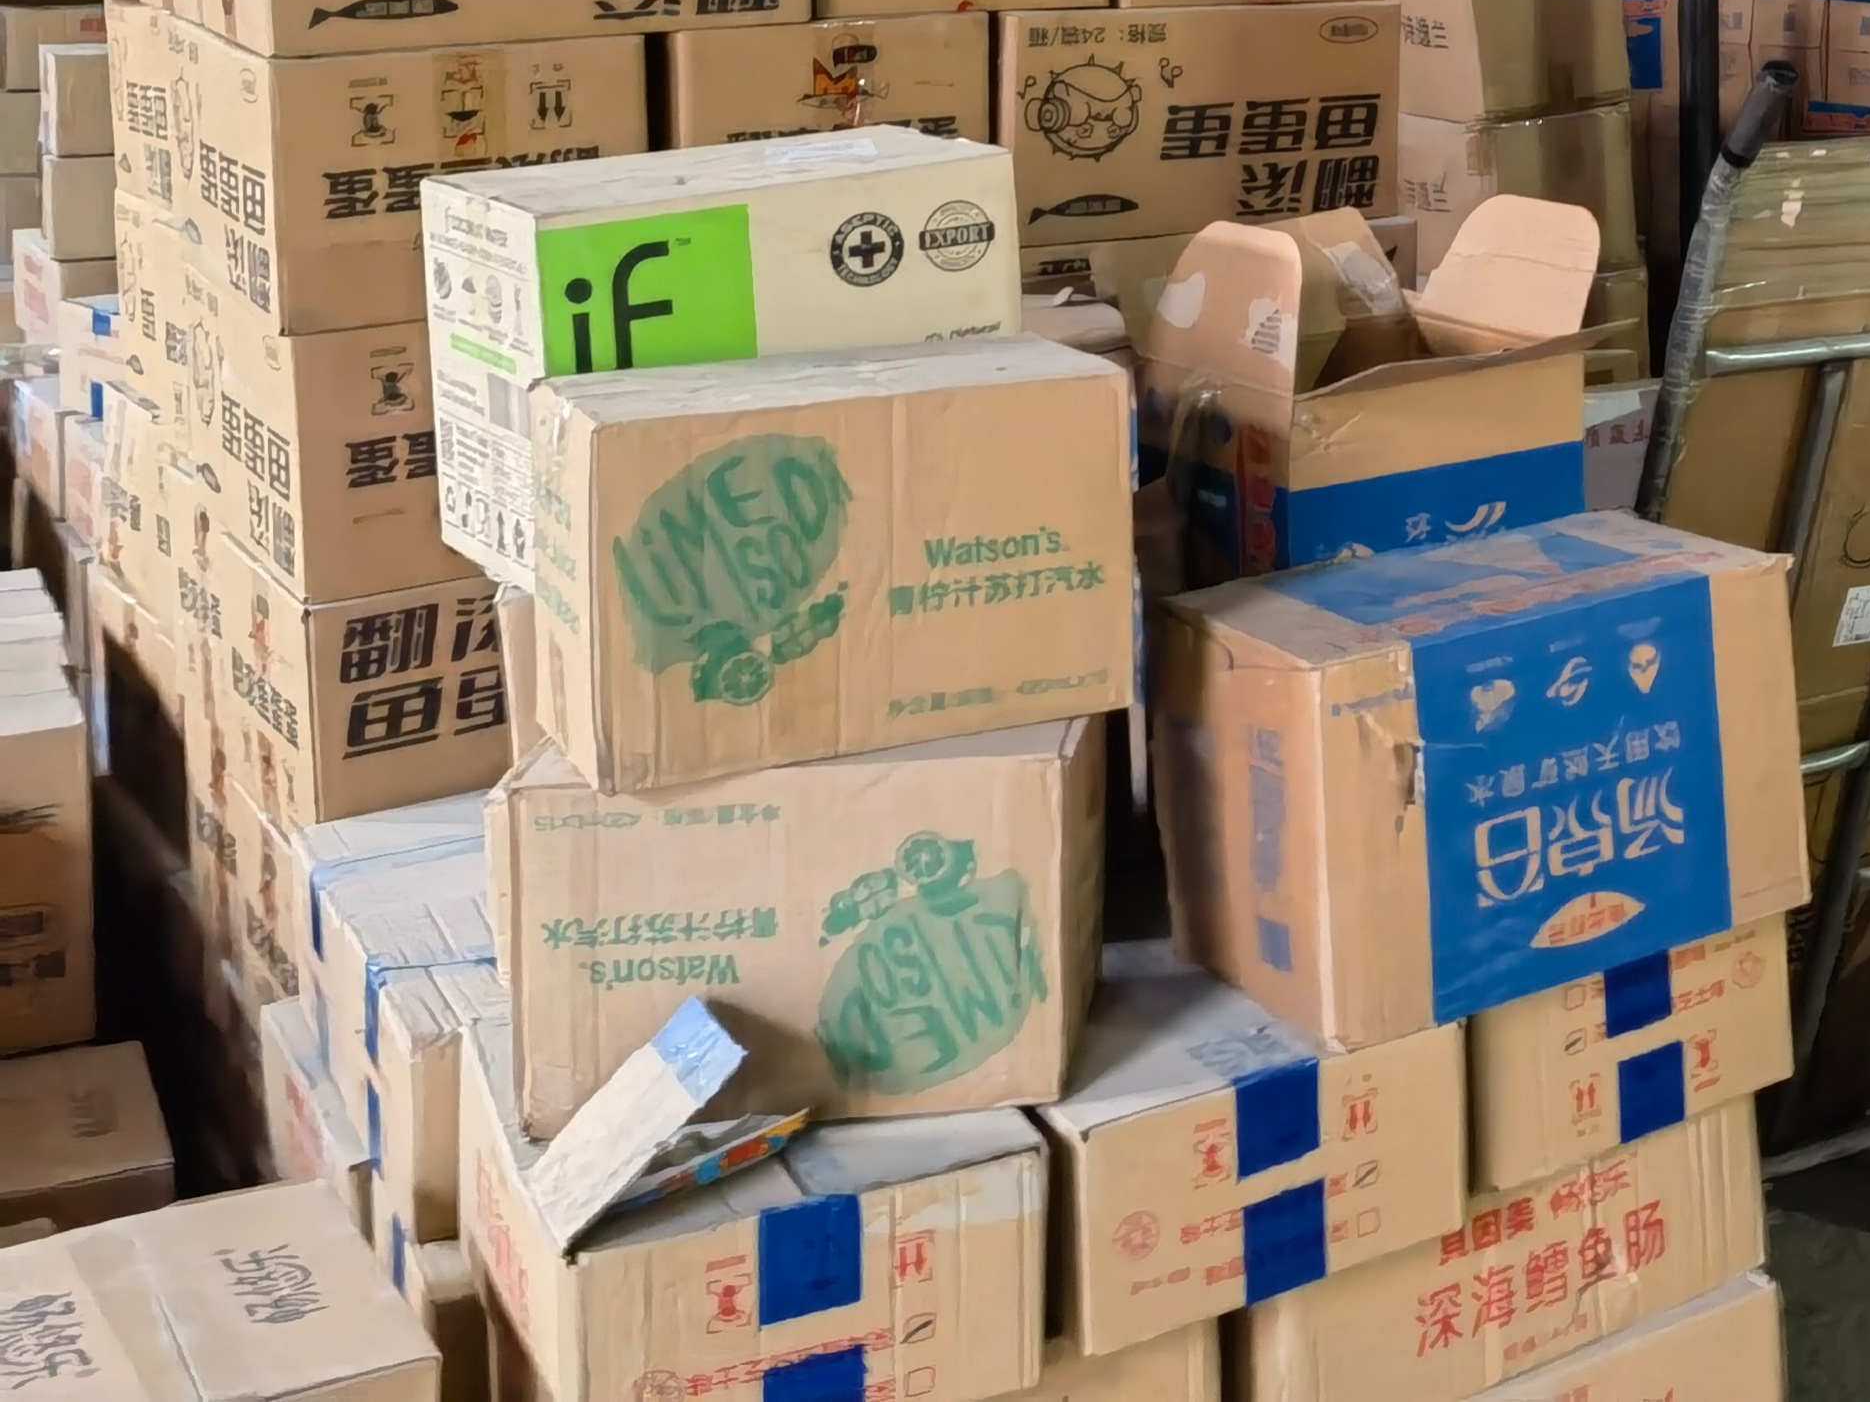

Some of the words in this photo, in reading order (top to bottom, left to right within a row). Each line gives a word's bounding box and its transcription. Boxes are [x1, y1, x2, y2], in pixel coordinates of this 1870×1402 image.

[1160, 94, 1381, 161] 鱼蛋蛋
[1237, 155, 1379, 217] 翻滚
[834, 212, 900, 245] ASEPTIC
[925, 221, 990, 249] EXPORT
[924, 525, 1061, 570] Watson's
[1465, 715, 1681, 807] 饮用天然矿泉水
[1414, 1200, 1667, 1358] 深海鳕鱼肠
